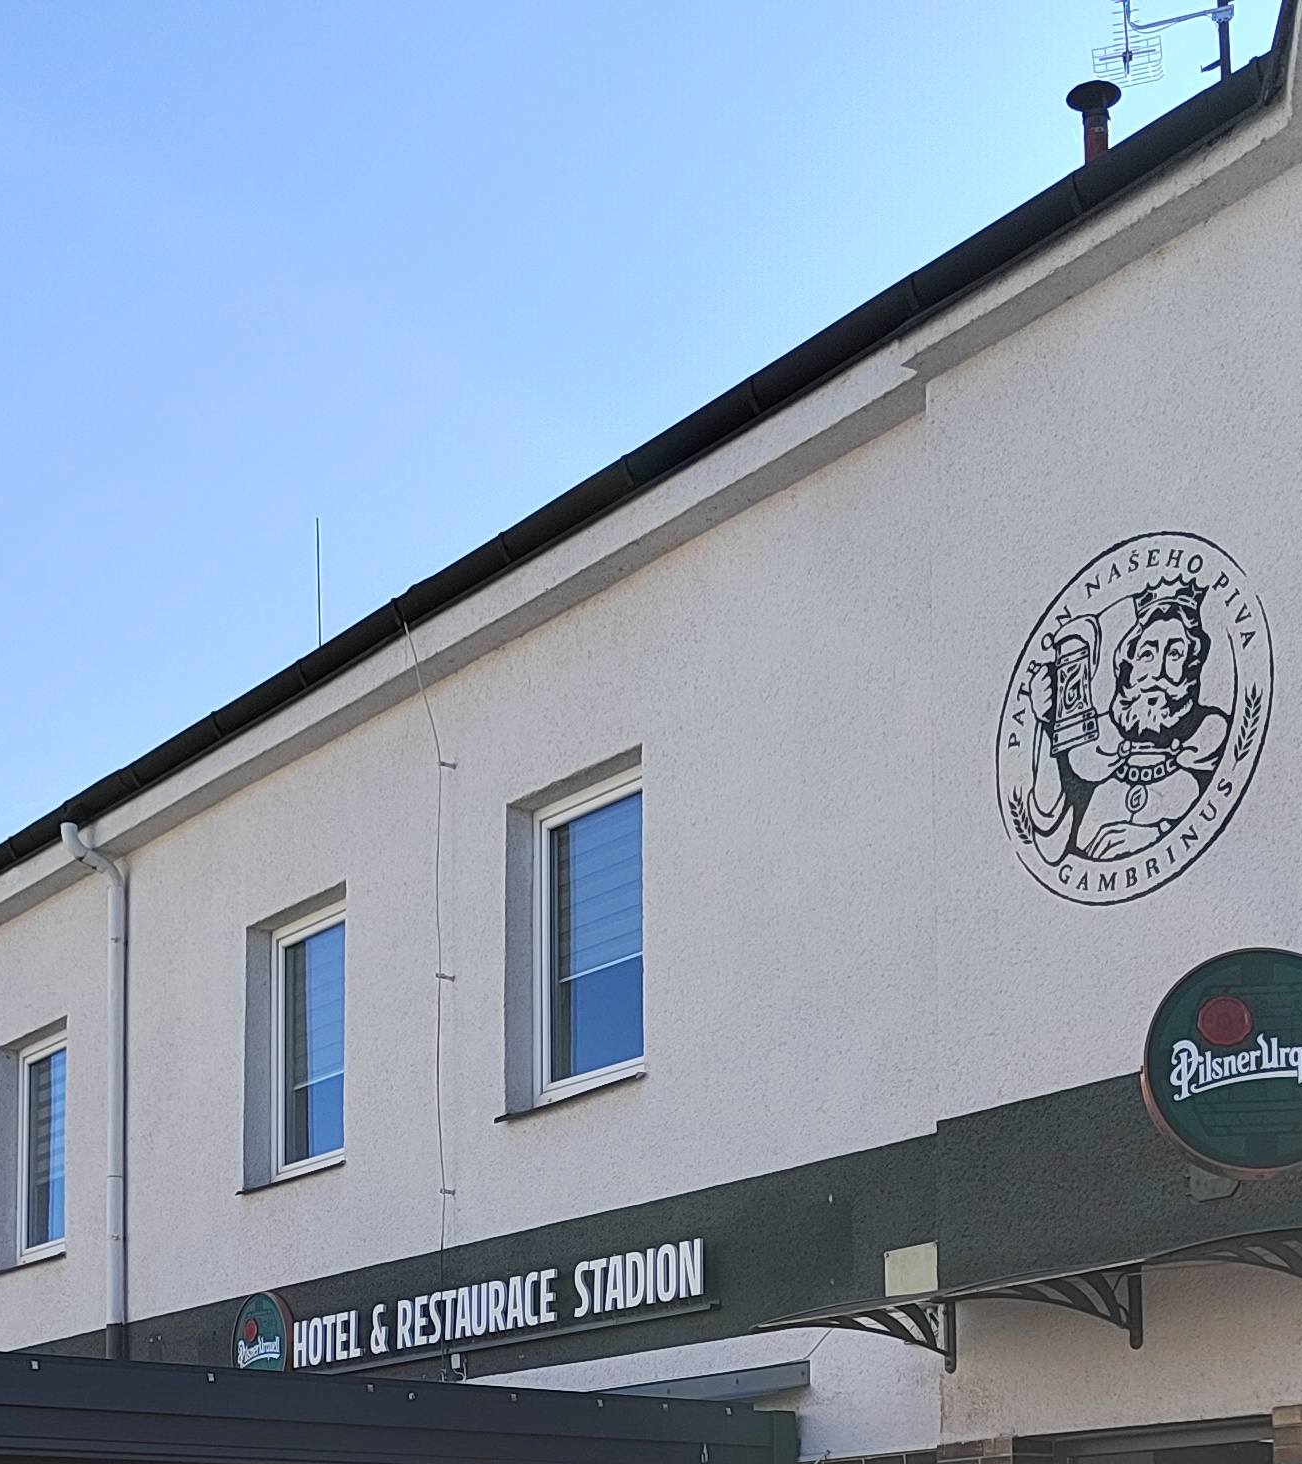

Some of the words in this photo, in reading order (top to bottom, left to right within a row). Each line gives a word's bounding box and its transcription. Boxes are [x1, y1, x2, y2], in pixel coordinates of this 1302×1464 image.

[1008, 605, 1072, 749] PATRON
[1084, 549, 1203, 600] NAŠEHO
[1211, 571, 1257, 649] PIVA
[1058, 776, 1235, 893] GAMBRINUS
[1169, 1039, 1261, 1102] Pilsner
[293, 1309, 362, 1369] HOTEL
[370, 1303, 389, 1353] &
[396, 1268, 559, 1350] RESTAURACE
[574, 1238, 705, 1318] STADION
